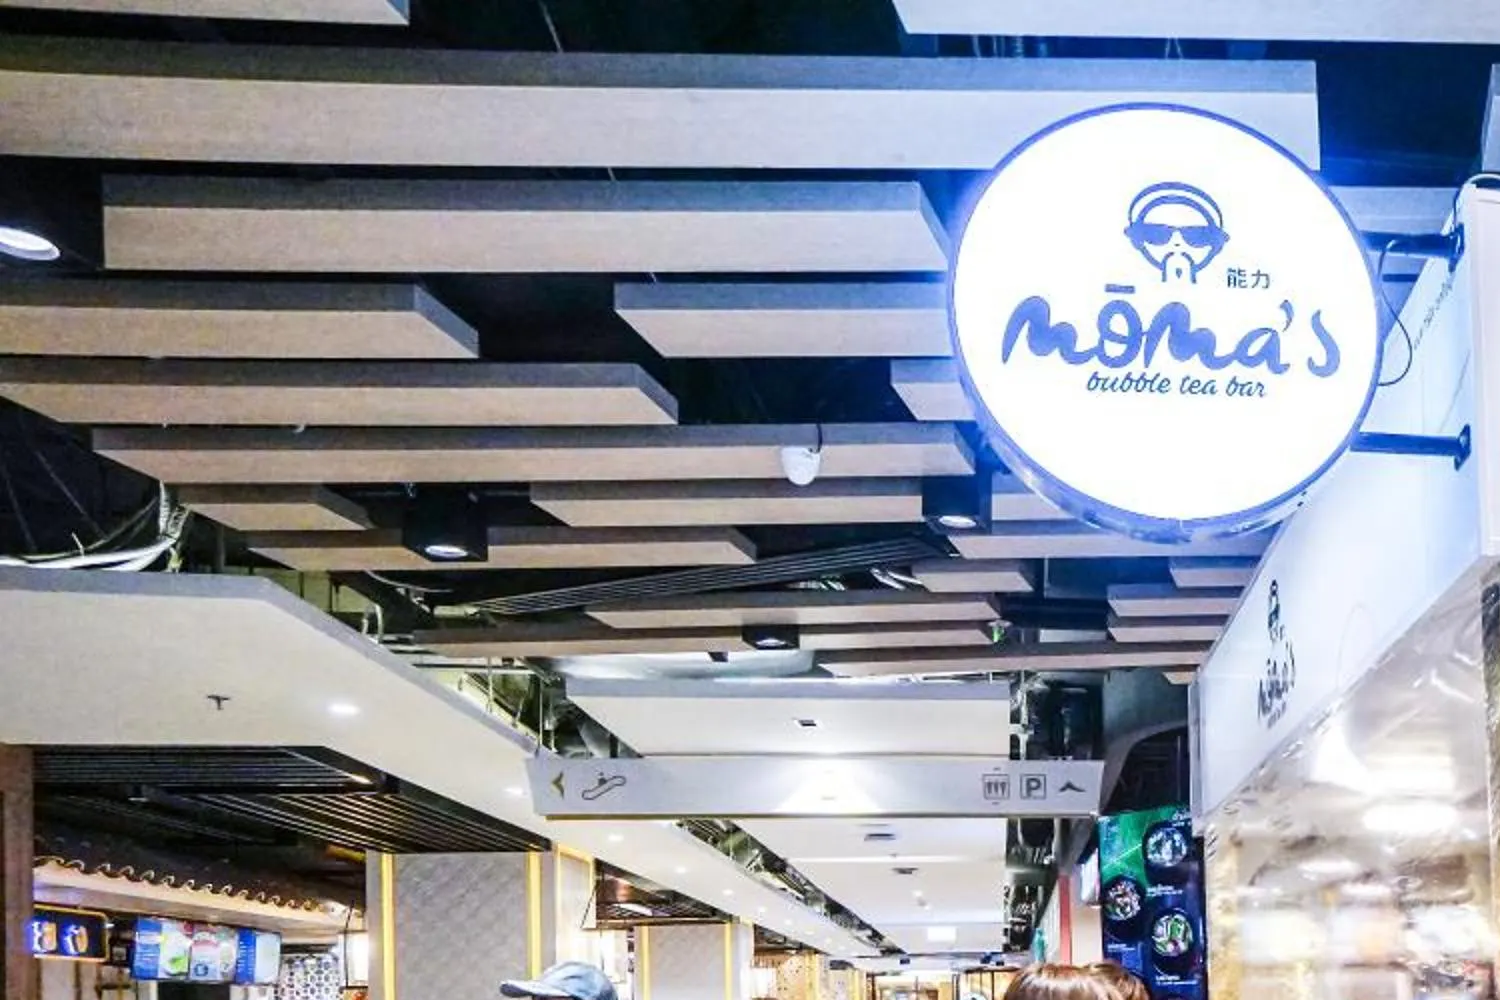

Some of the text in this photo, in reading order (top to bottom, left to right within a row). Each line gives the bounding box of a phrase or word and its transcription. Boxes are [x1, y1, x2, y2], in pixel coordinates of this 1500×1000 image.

[1226, 266, 1271, 289] 能力
[1086, 371, 1266, 398] bubble tea bar
[1025, 777, 1042, 798] P
